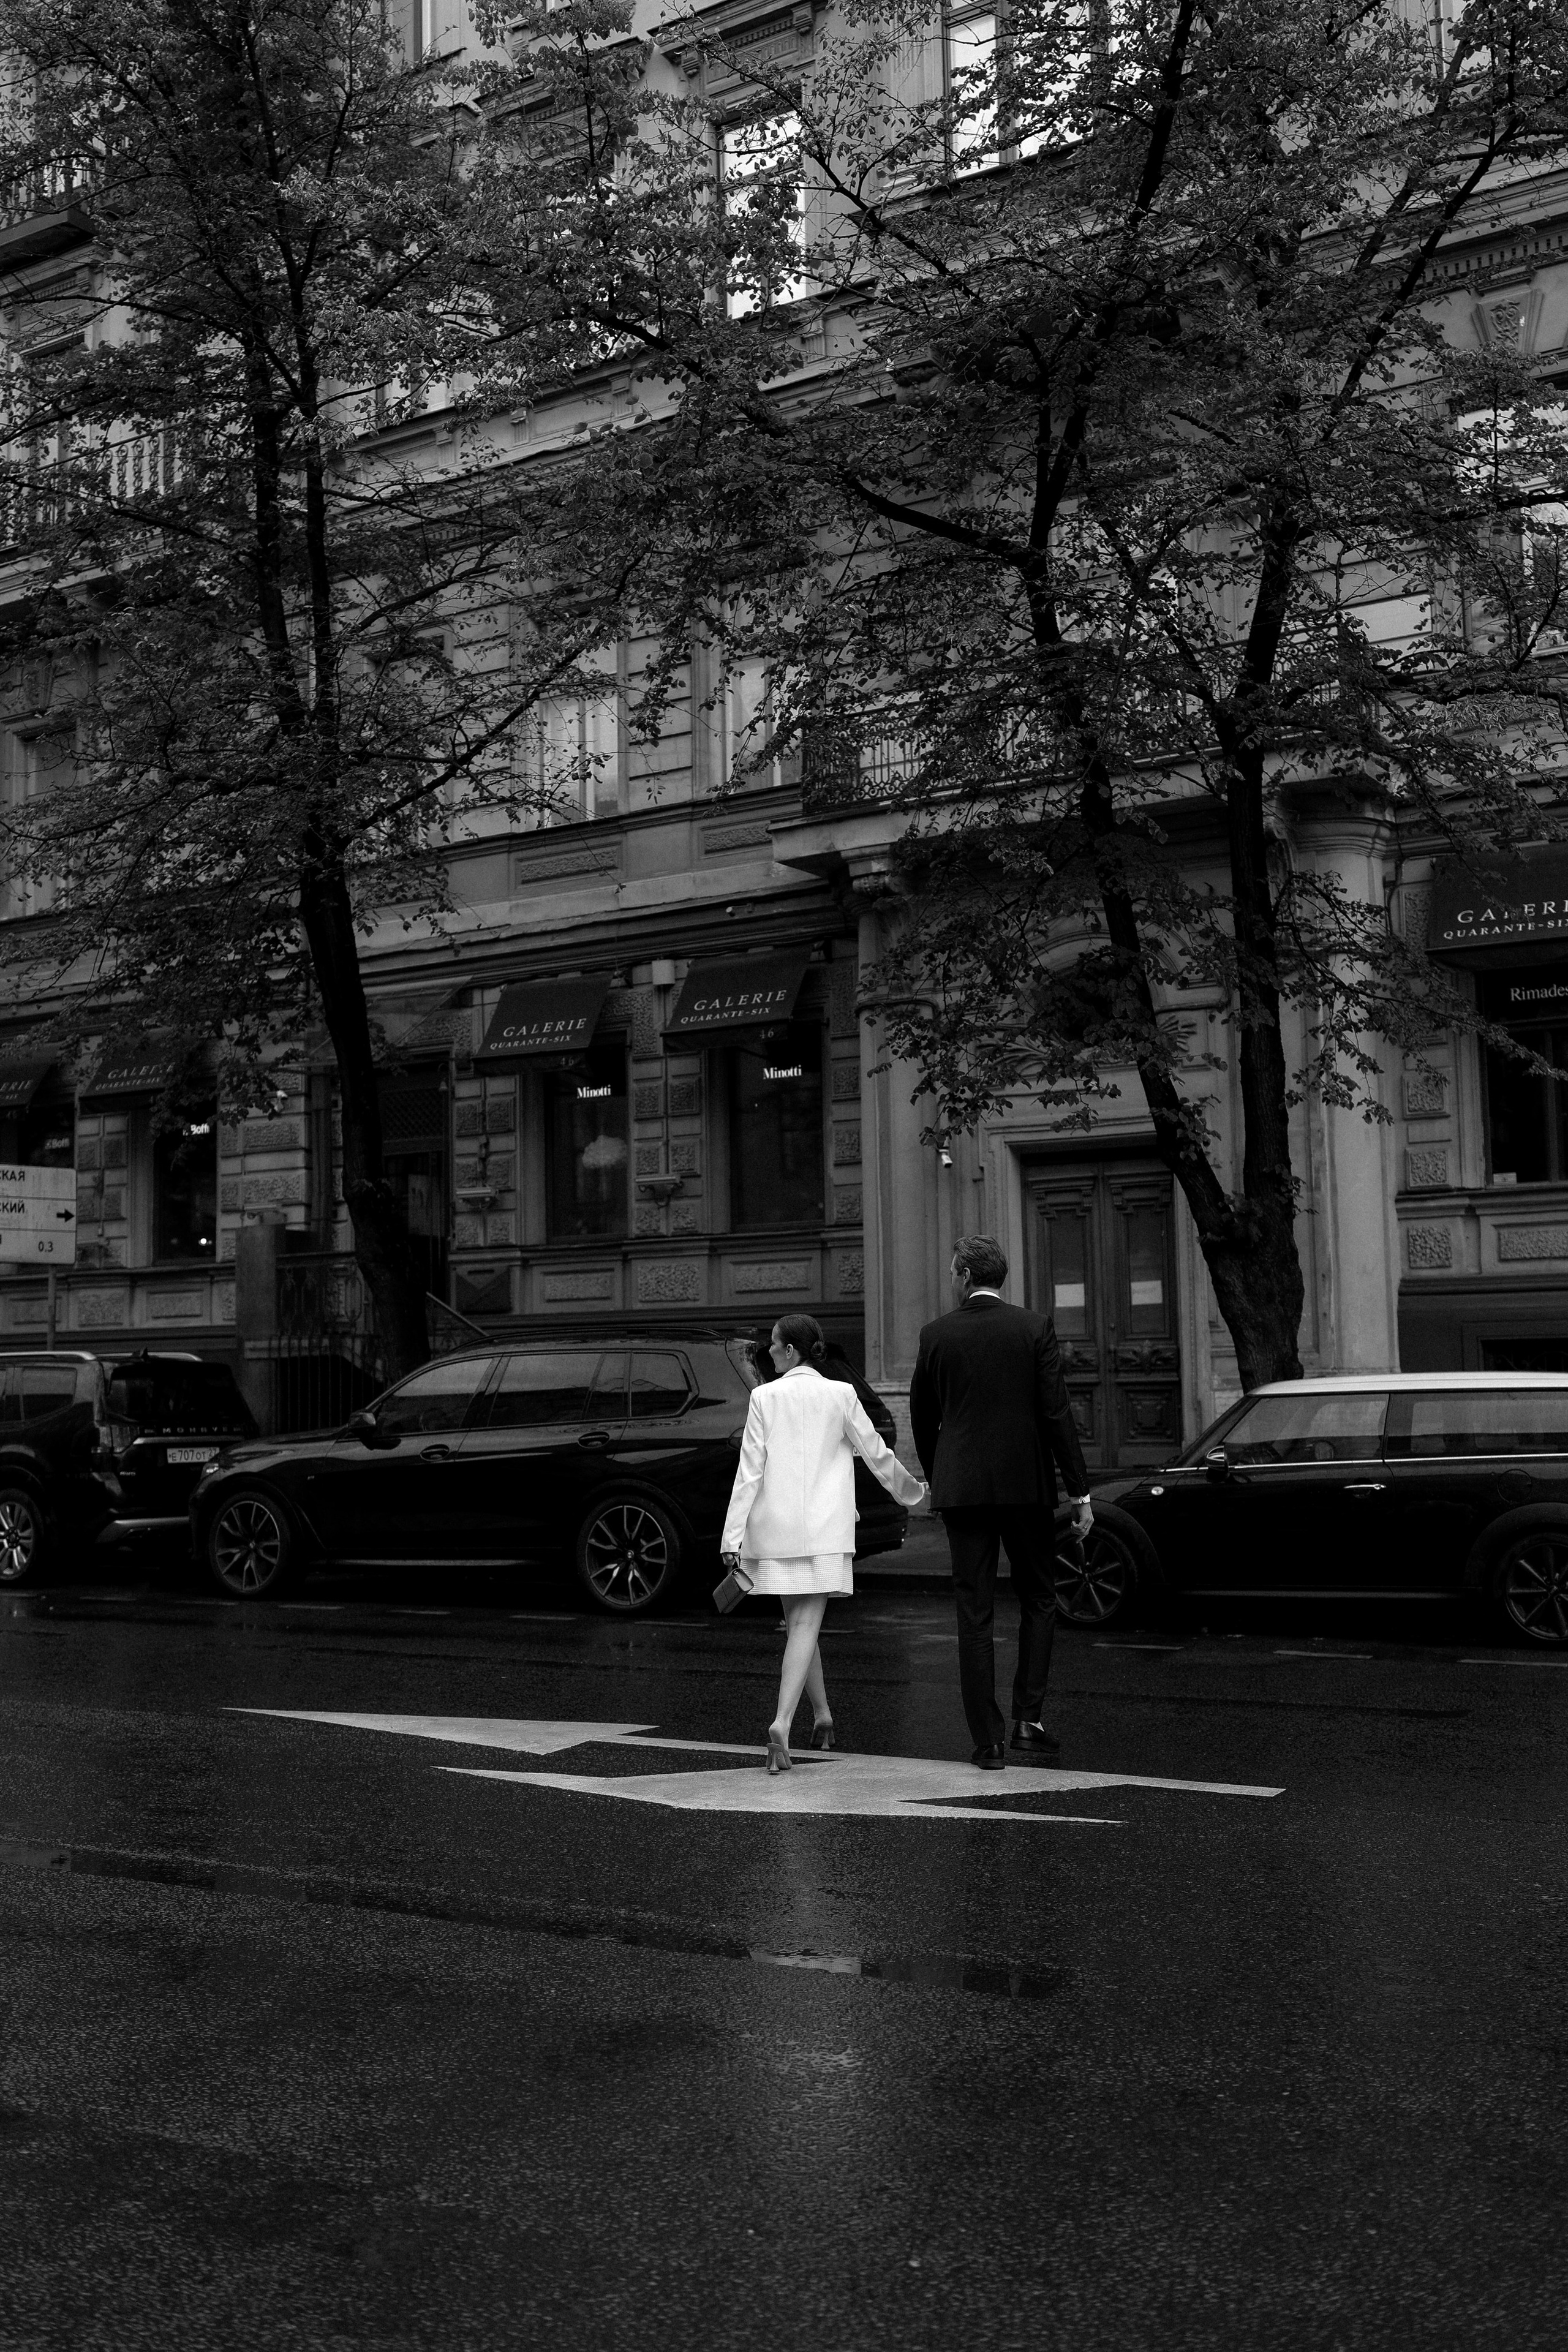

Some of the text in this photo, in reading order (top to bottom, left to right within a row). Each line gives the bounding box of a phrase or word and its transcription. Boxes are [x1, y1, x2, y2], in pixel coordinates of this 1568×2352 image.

[694, 990, 787, 1011] GALERIE
[680, 1008, 771, 1023] QUARANTE-SIX
[503, 1018, 587, 1037] GALERIE
[490, 1035, 571, 1050] QUARANTE-SIX
[763, 1065, 802, 1080] Minotti
[576, 1084, 611, 1099] Minotti
[38, 1241, 53, 1252] 0.3
